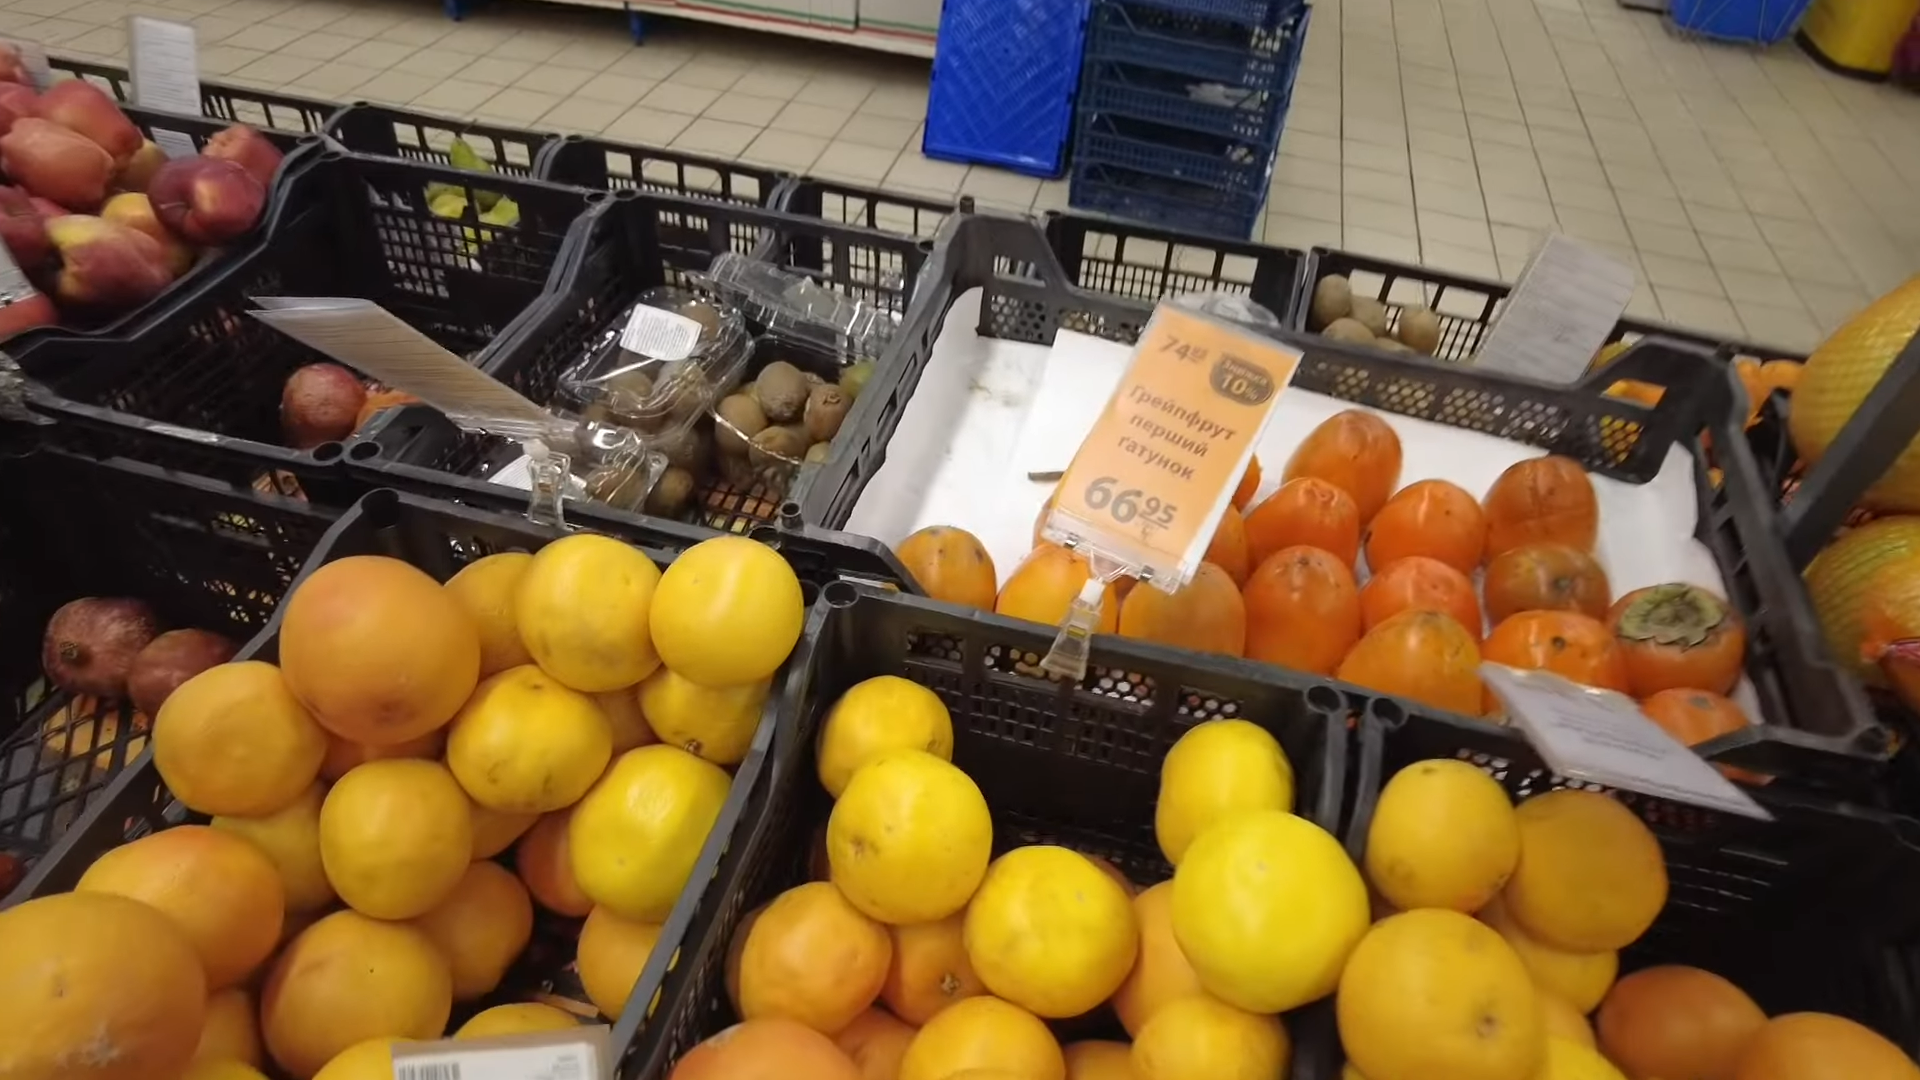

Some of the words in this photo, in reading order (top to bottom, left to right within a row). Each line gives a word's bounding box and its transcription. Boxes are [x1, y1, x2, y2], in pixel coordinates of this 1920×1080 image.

[1221, 374, 1258, 401] 10%
[1129, 385, 1236, 440] Грейпфрут
[1130, 413, 1209, 457] перший
[1118, 435, 1195, 480] ґатунок
